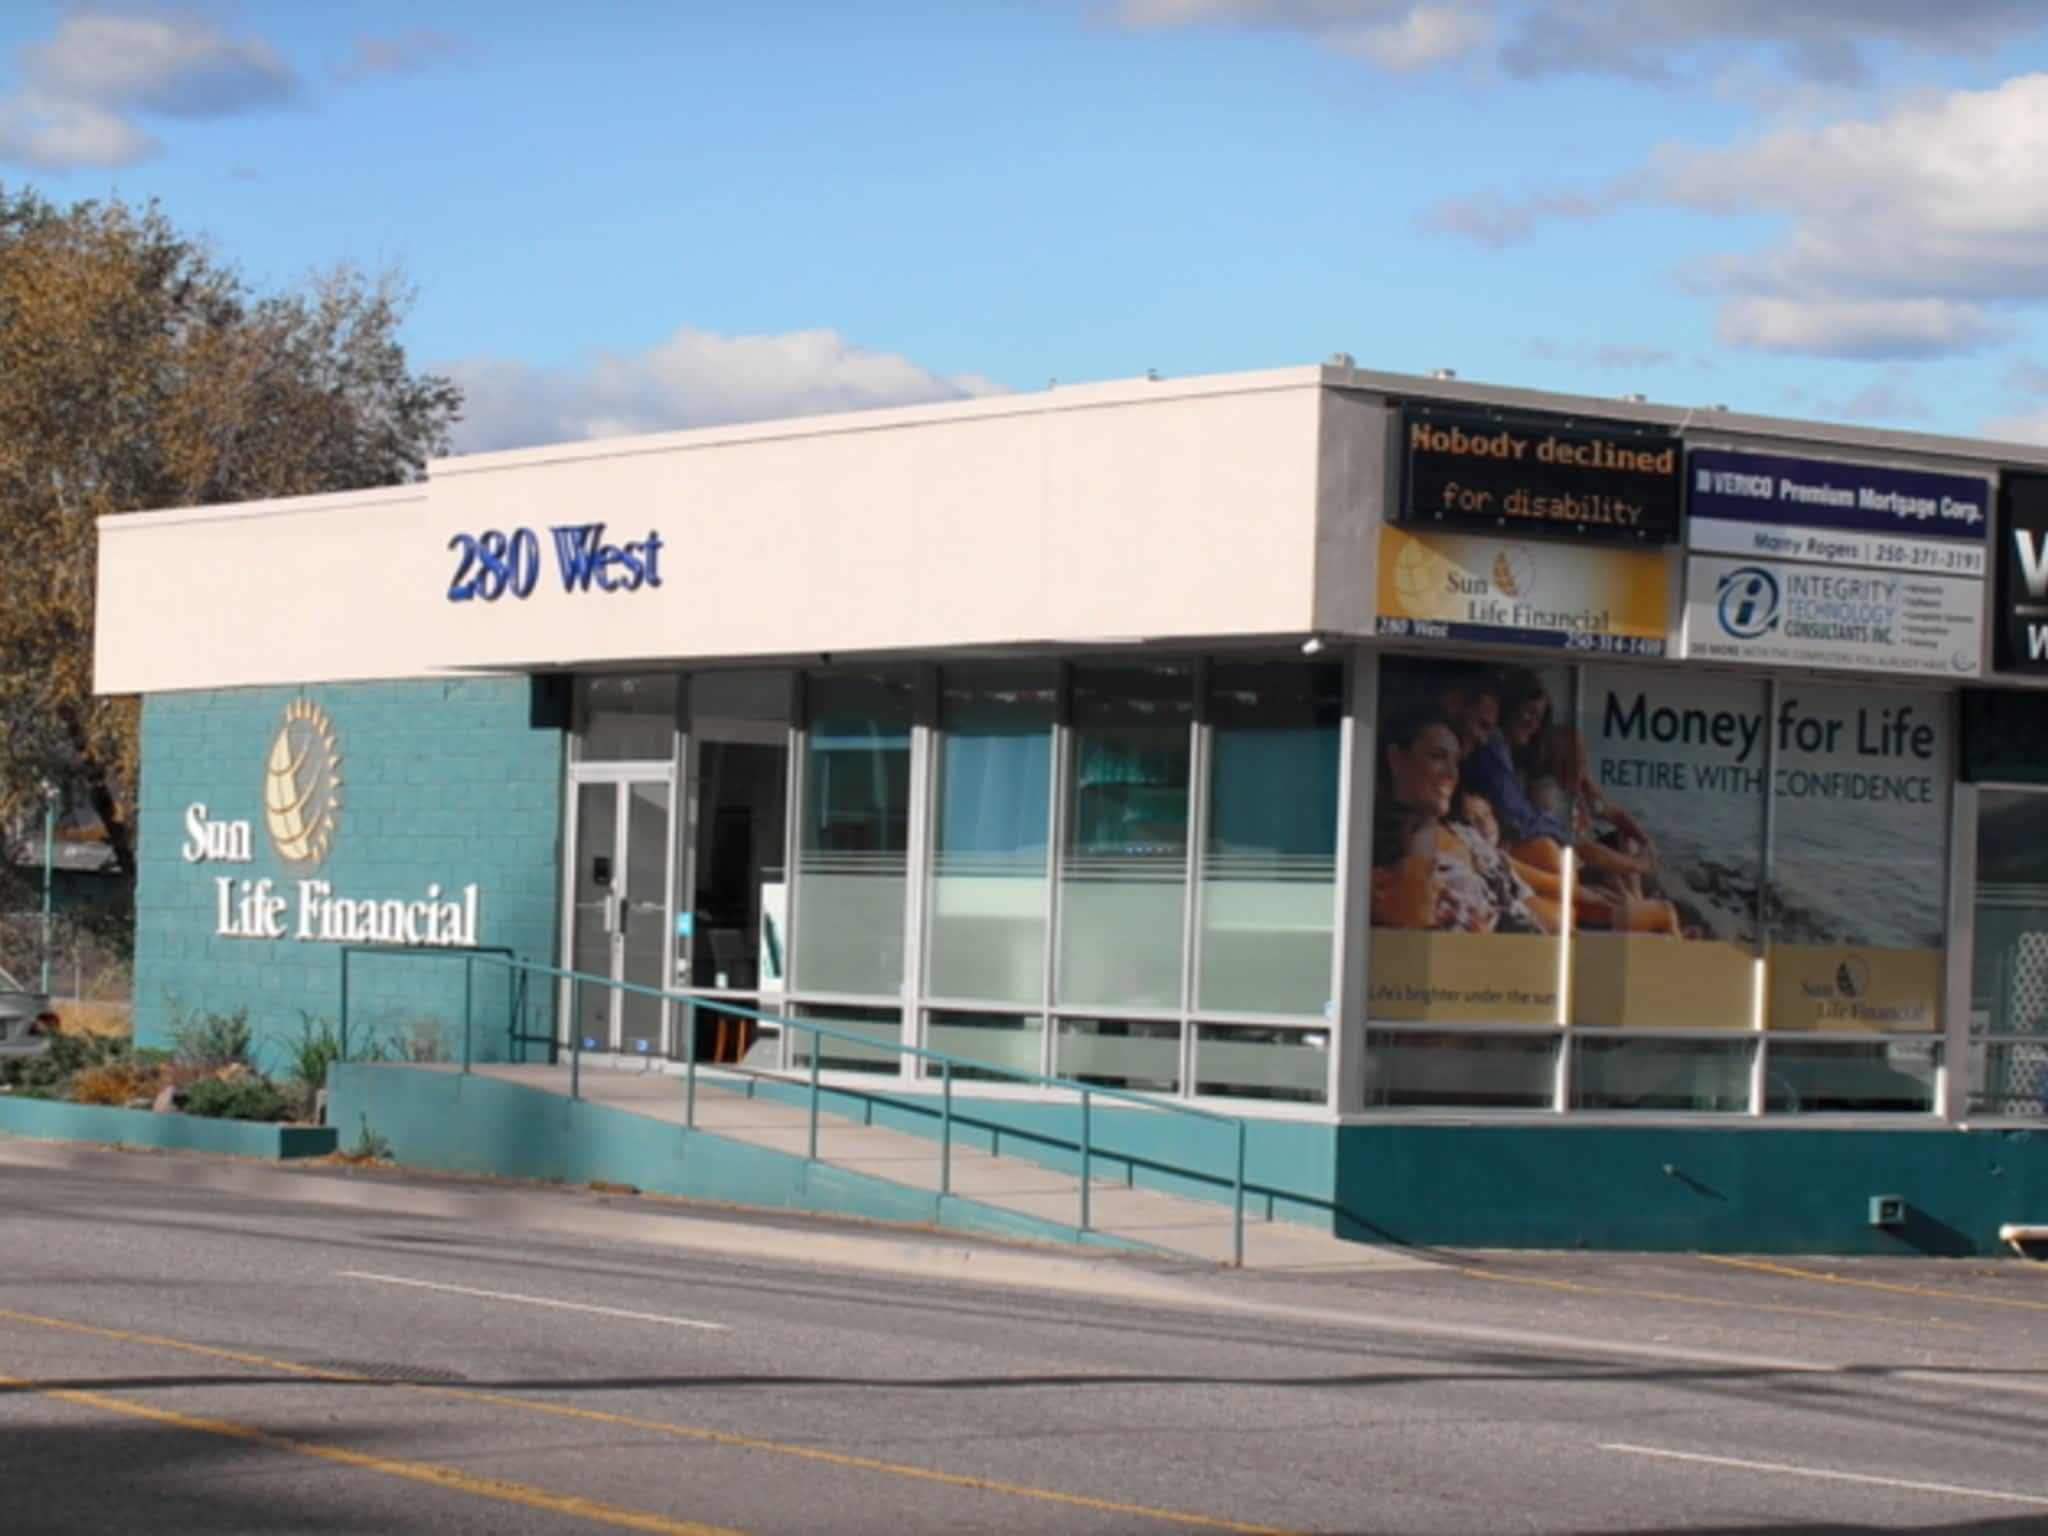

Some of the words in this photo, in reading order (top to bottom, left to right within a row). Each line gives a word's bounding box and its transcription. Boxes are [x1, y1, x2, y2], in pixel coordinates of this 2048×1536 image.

[1410, 422, 1527, 460] Nobody
[1536, 435, 1675, 474] declined
[1442, 481, 1492, 511] for
[1503, 489, 1642, 525] disability
[1779, 478, 1855, 507] Premium
[1859, 488, 1936, 520] Mortgage
[1940, 496, 1983, 525] Corp.
[447, 526, 541, 602] 280
[548, 521, 664, 594] West
[1445, 572, 1489, 596] Sun
[1786, 574, 1897, 600] INTEGRITY
[1467, 601, 1507, 622] Life
[1513, 603, 1611, 631] Financial
[1783, 619, 1868, 642] CONSULTANTS
[1786, 597, 1896, 624] TECHNOLOGY
[1602, 690, 1763, 763] Money
[1778, 700, 1844, 753] for
[1857, 705, 1935, 759] Life
[1601, 759, 1687, 791] RETIRE
[1693, 765, 1765, 794] WITH
[1775, 769, 1934, 804] CONFIDENCE
[182, 801, 252, 863] Sun
[215, 876, 287, 938] Life
[295, 879, 479, 947] Financial
